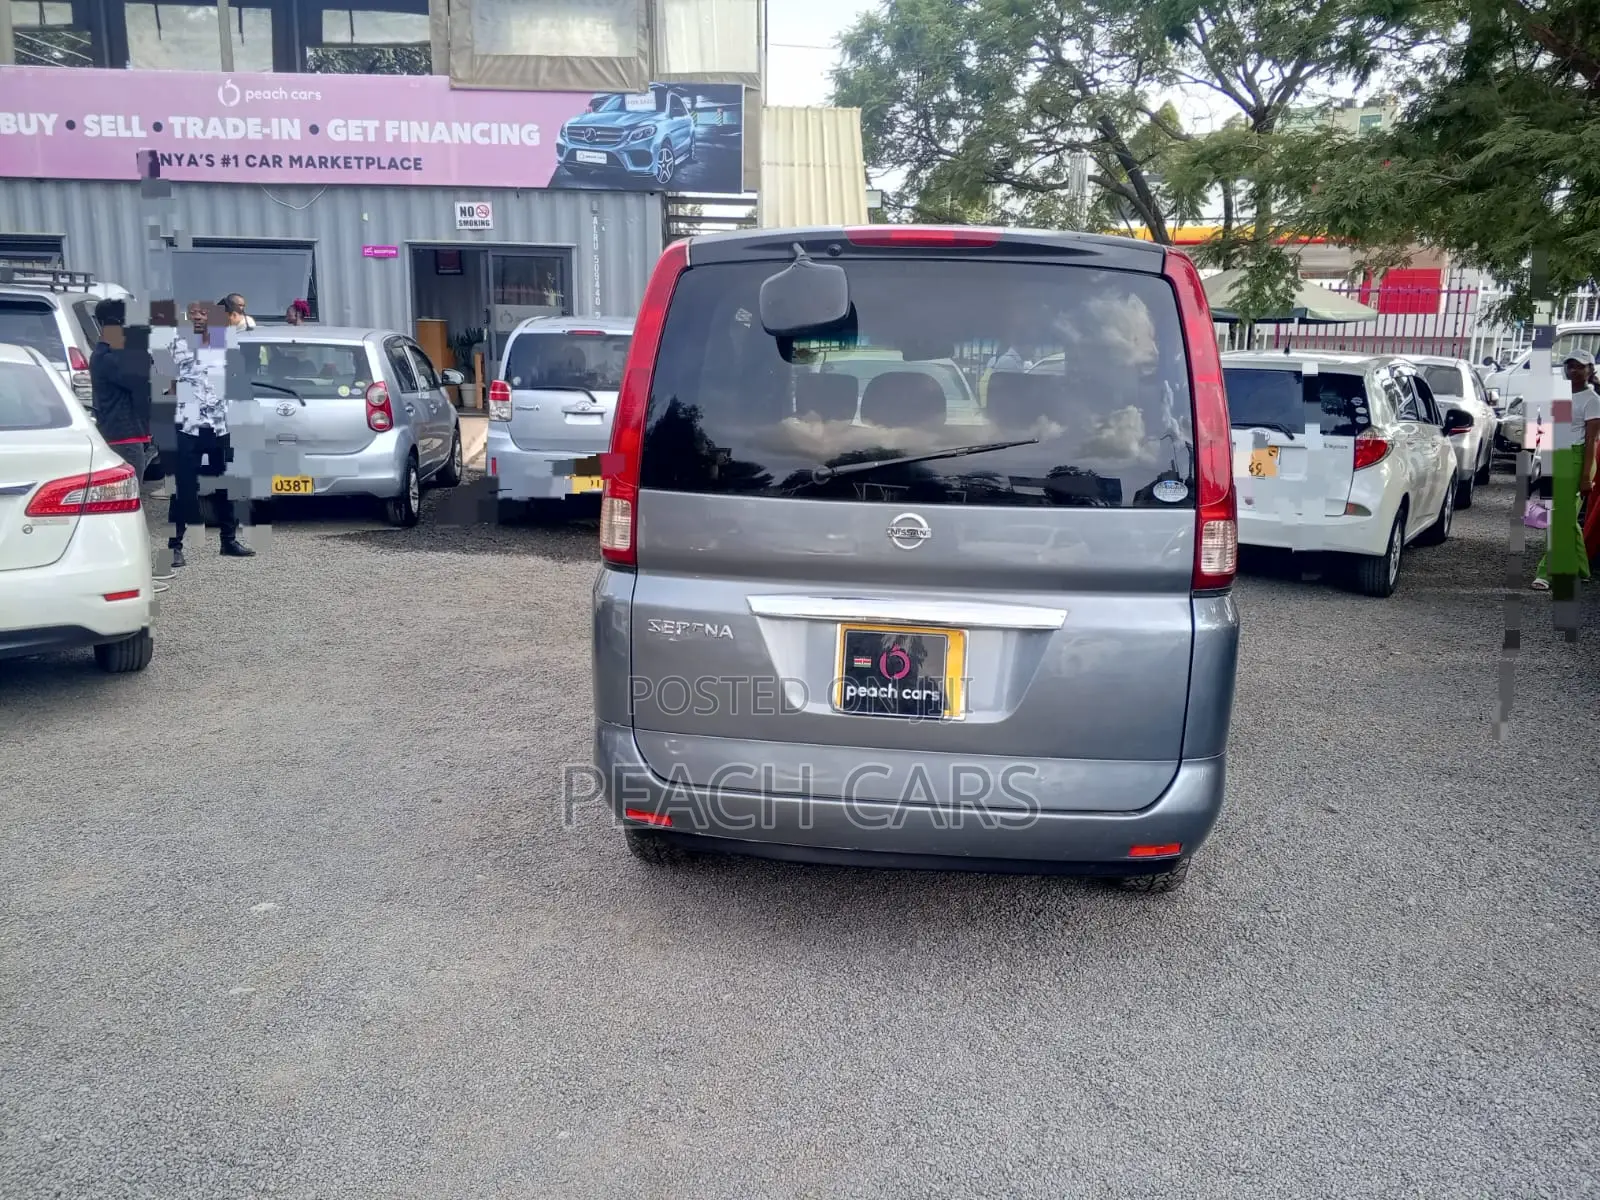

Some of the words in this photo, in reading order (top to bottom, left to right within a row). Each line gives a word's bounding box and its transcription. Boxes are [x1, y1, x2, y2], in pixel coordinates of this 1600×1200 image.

[246, 86, 287, 103] peach
[291, 89, 322, 101] cars
[0, 112, 59, 136] BUY
[83, 114, 148, 138] SELL
[168, 116, 301, 141] TRADE-IN
[327, 118, 381, 143] GET
[385, 119, 541, 146] FINANCING
[220, 154, 239, 168] #1
[245, 154, 283, 168] CAR
[289, 155, 423, 171] MARKETPLACE
[459, 206, 475, 217] NO
[458, 219, 491, 227] SMOKING
[890, 527, 927, 537] NISSAN
[846, 683, 898, 701] peach
[902, 687, 940, 702] cars
